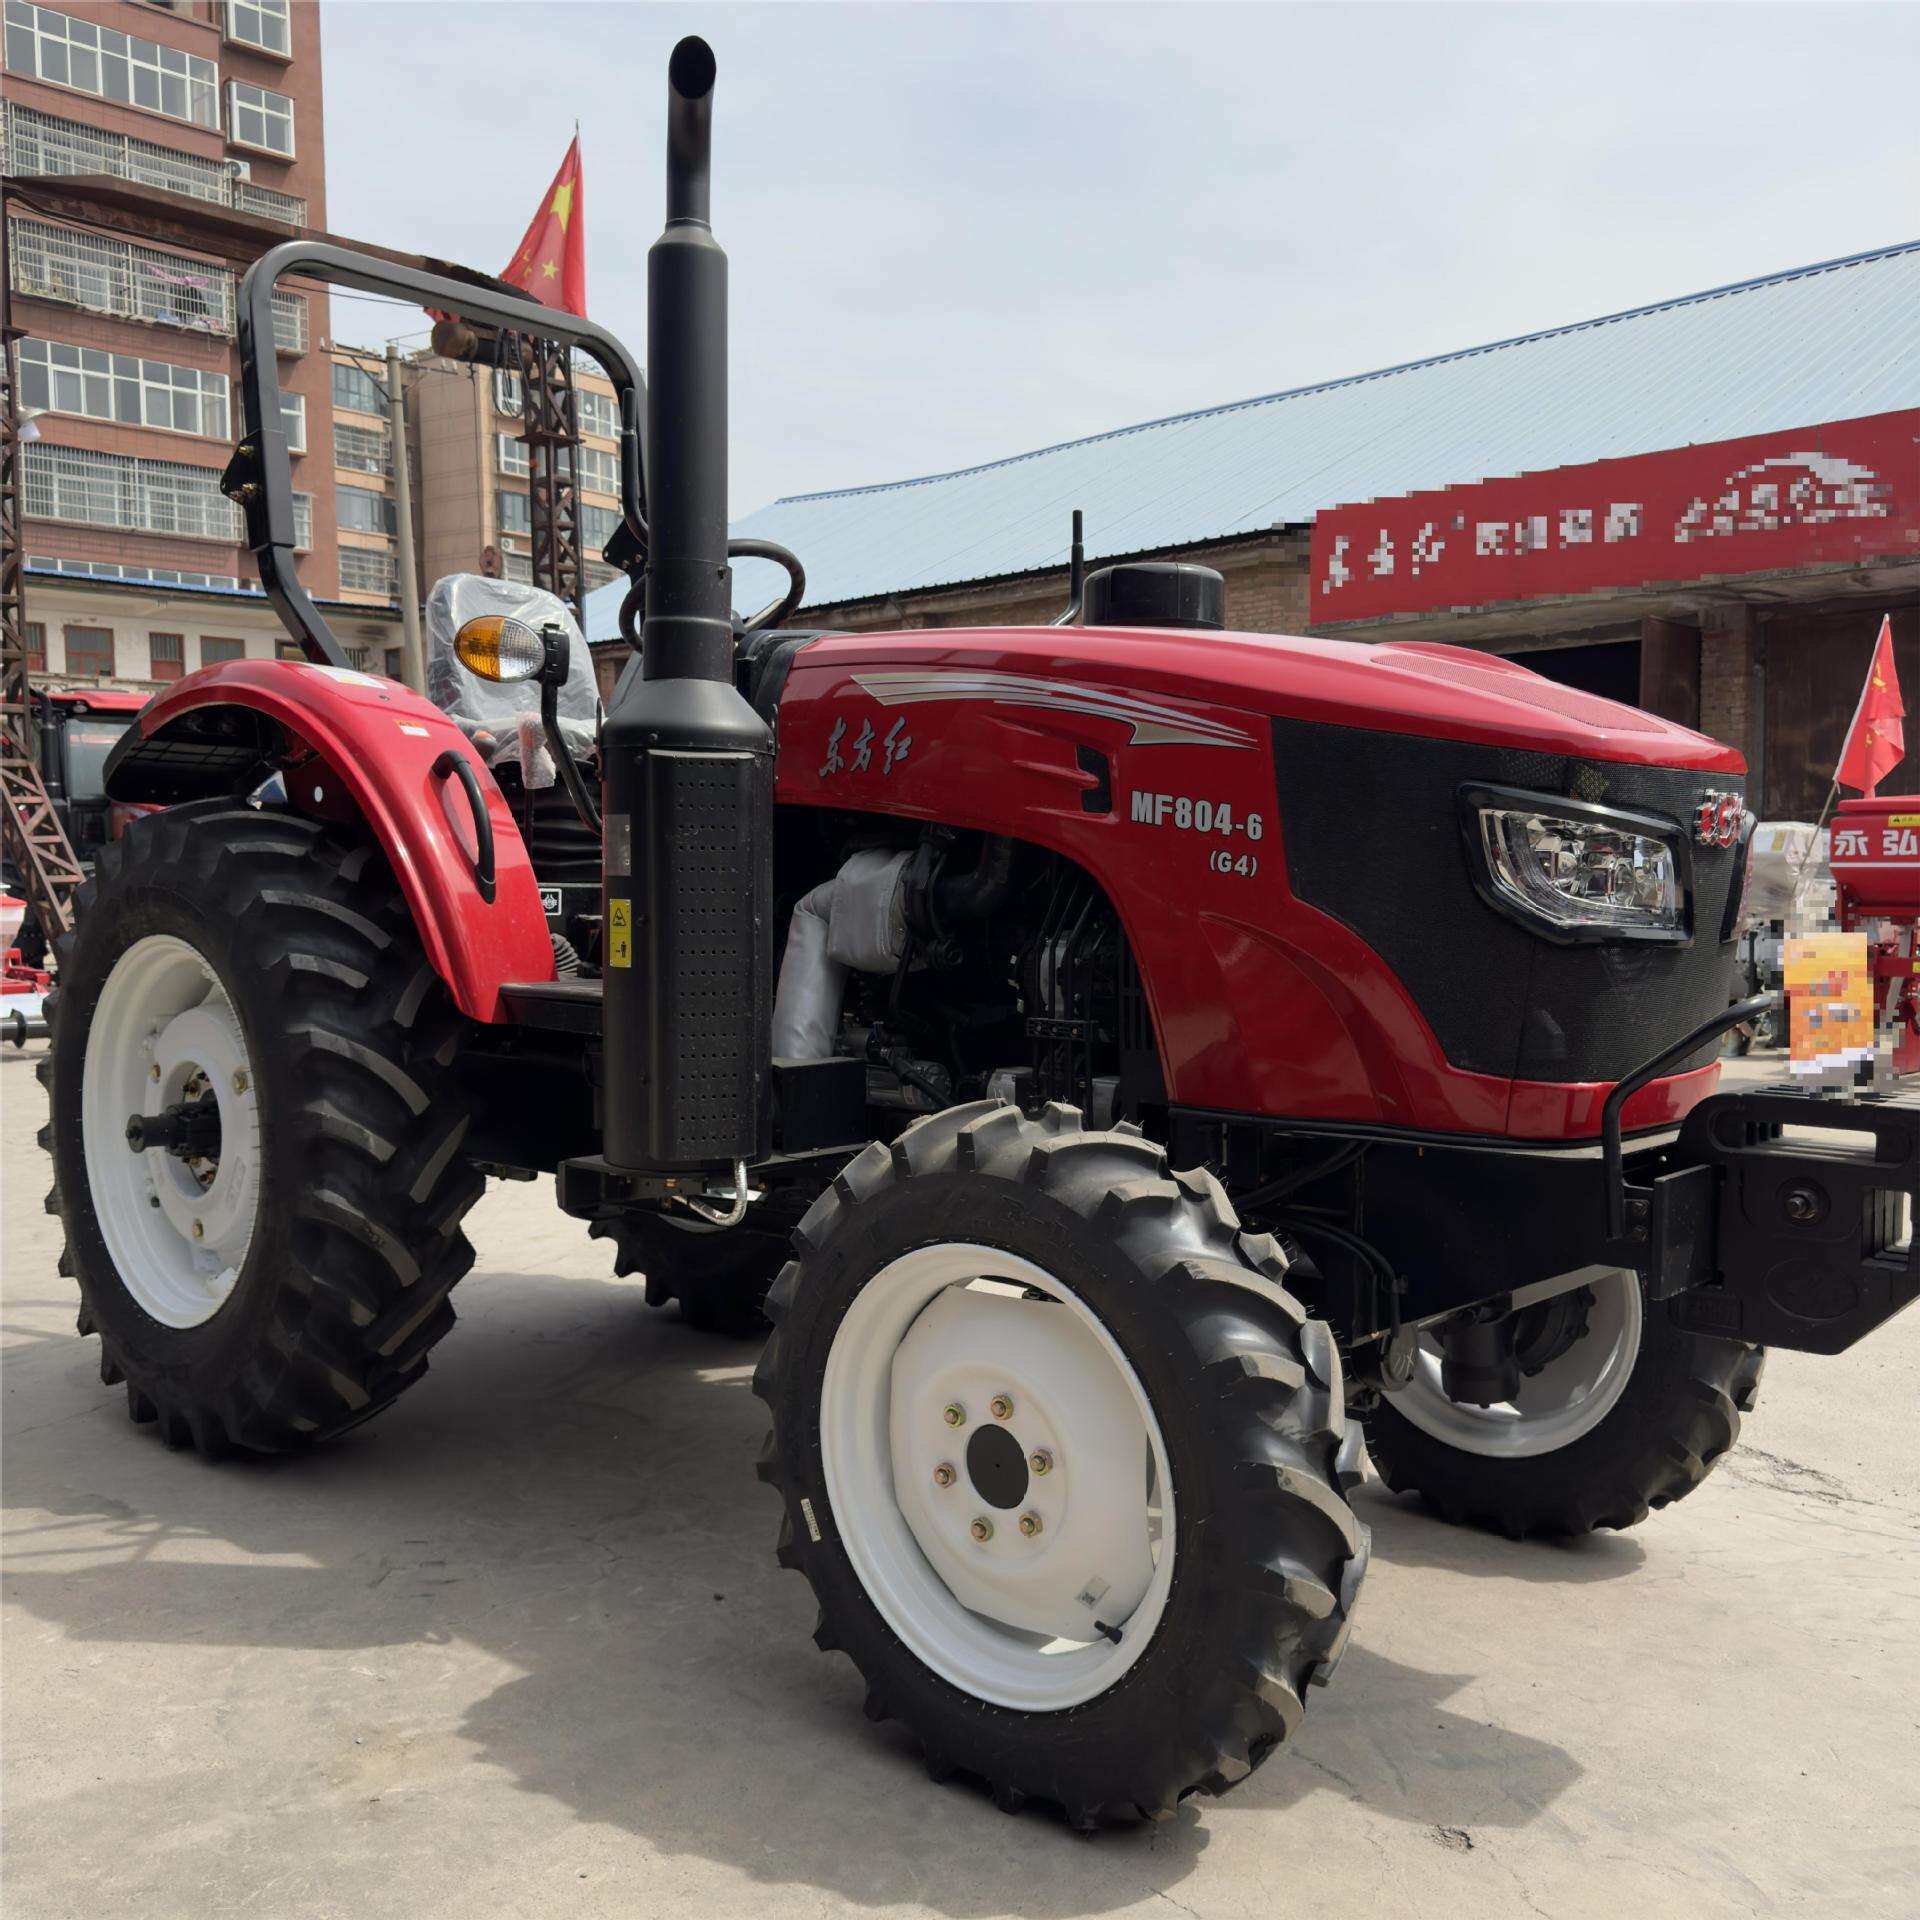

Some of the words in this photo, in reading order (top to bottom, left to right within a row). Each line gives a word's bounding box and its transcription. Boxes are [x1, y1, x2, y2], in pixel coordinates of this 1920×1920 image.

[819, 716, 912, 777] 东方红
[1131, 790, 1263, 840] MF804-6
[1210, 850, 1257, 877] (G4)
